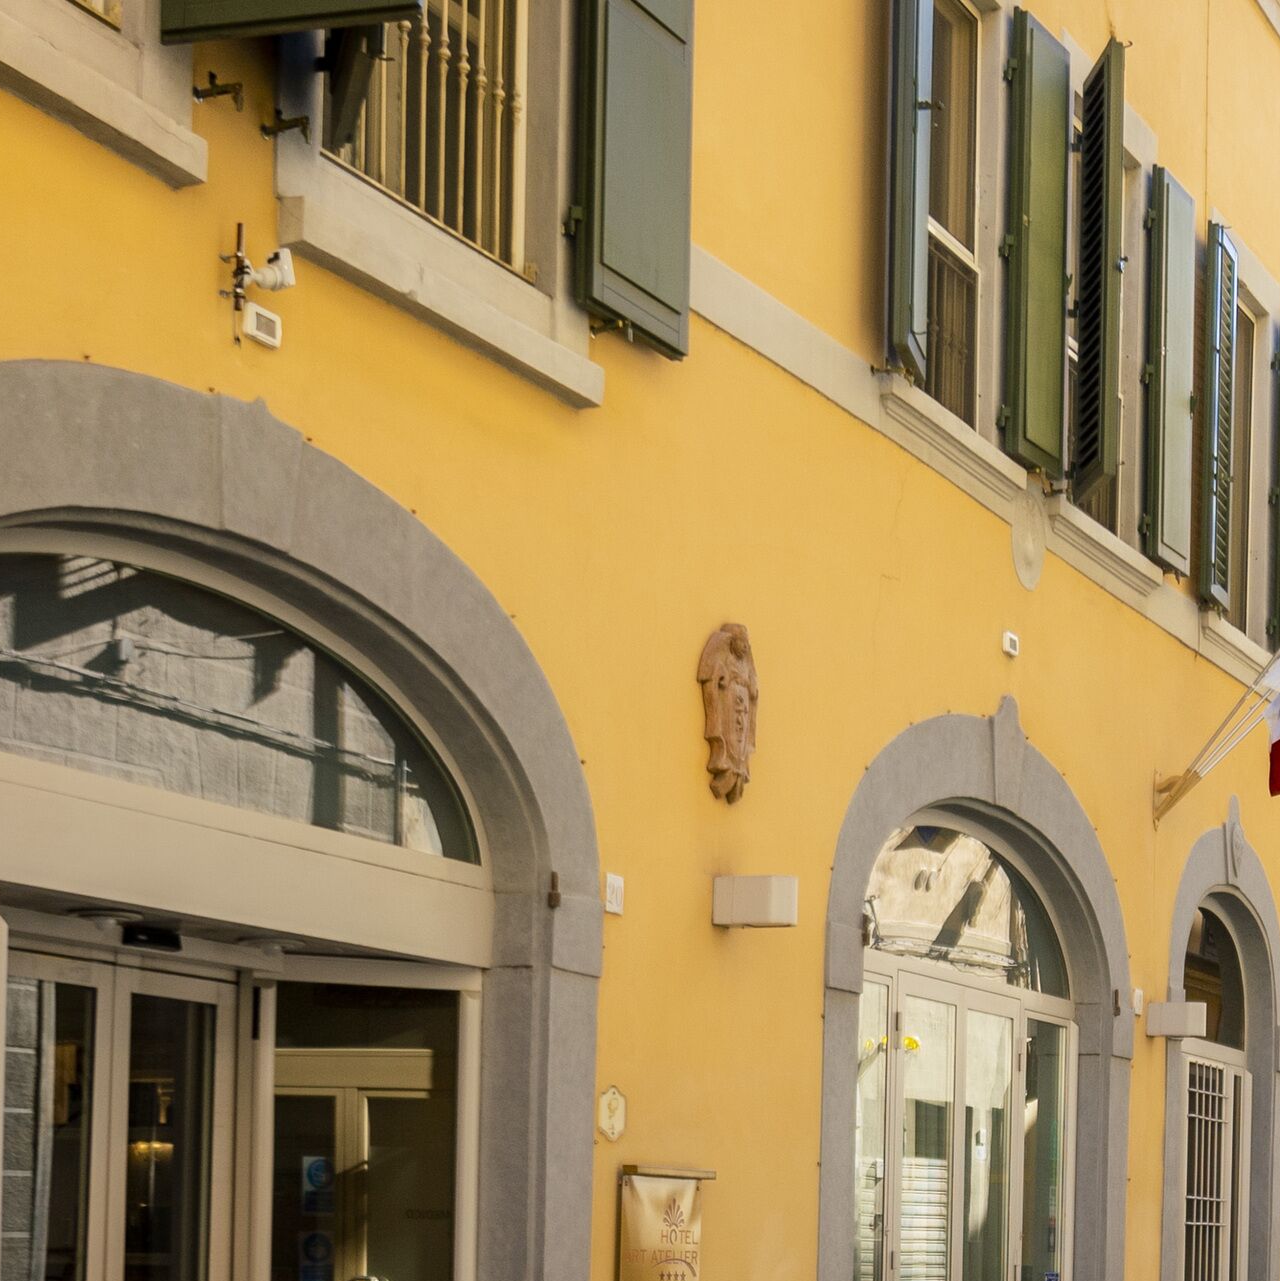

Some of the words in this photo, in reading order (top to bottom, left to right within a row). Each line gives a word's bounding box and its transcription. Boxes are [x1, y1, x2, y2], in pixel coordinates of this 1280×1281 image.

[661, 1229, 698, 1245] HOTEL
[624, 1248, 647, 1264] ART
[651, 1248, 698, 1265] ATELIER
